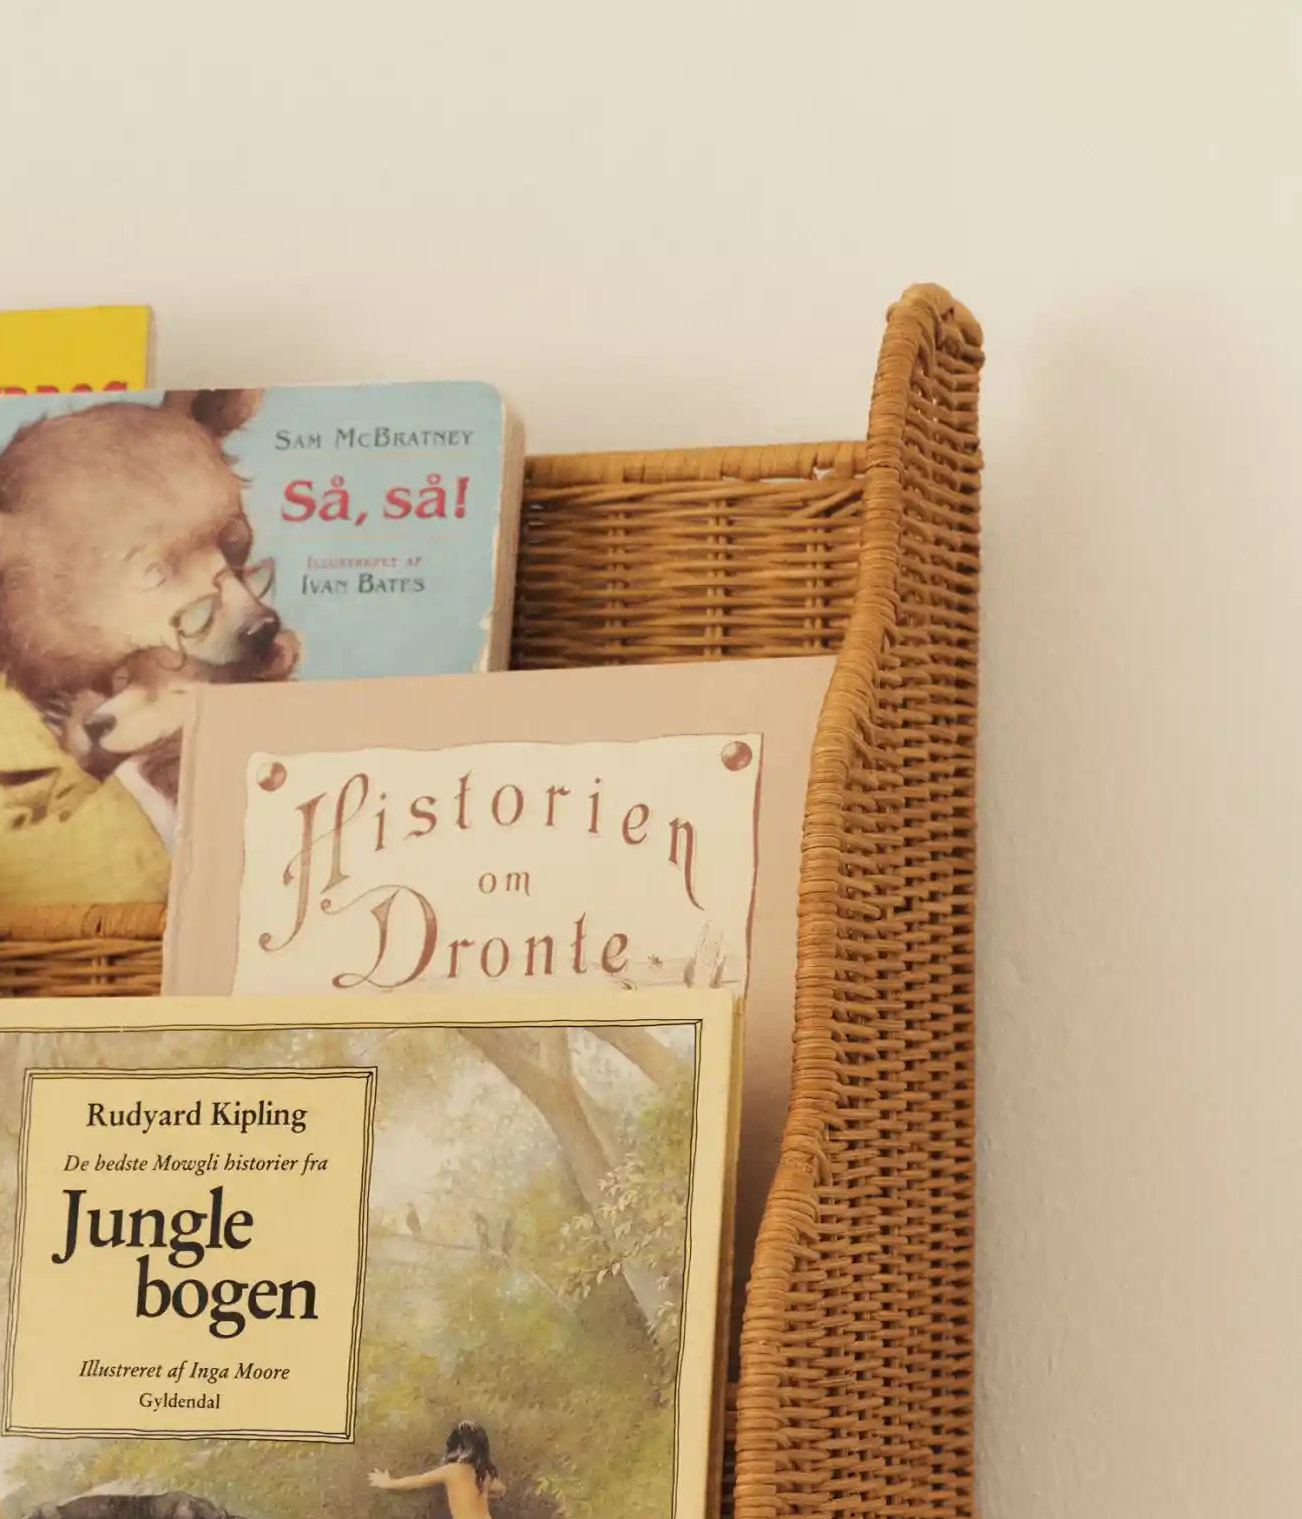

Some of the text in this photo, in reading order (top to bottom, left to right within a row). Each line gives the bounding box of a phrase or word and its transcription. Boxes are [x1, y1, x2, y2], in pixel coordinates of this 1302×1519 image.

[280, 472, 471, 527] Så, så!
[258, 770, 705, 952] Historien
[477, 867, 531, 896] om
[319, 883, 632, 990] Dronte
[85, 1099, 308, 1134] Rudyard Kipling
[63, 1152, 329, 1177] De bedste Mowgli historier fra
[51, 1185, 254, 1268] Jungle
[135, 1254, 319, 1339] bogen
[78, 1359, 291, 1383] Illustreret af Inga Moore
[138, 1392, 221, 1413] Gyldendal
